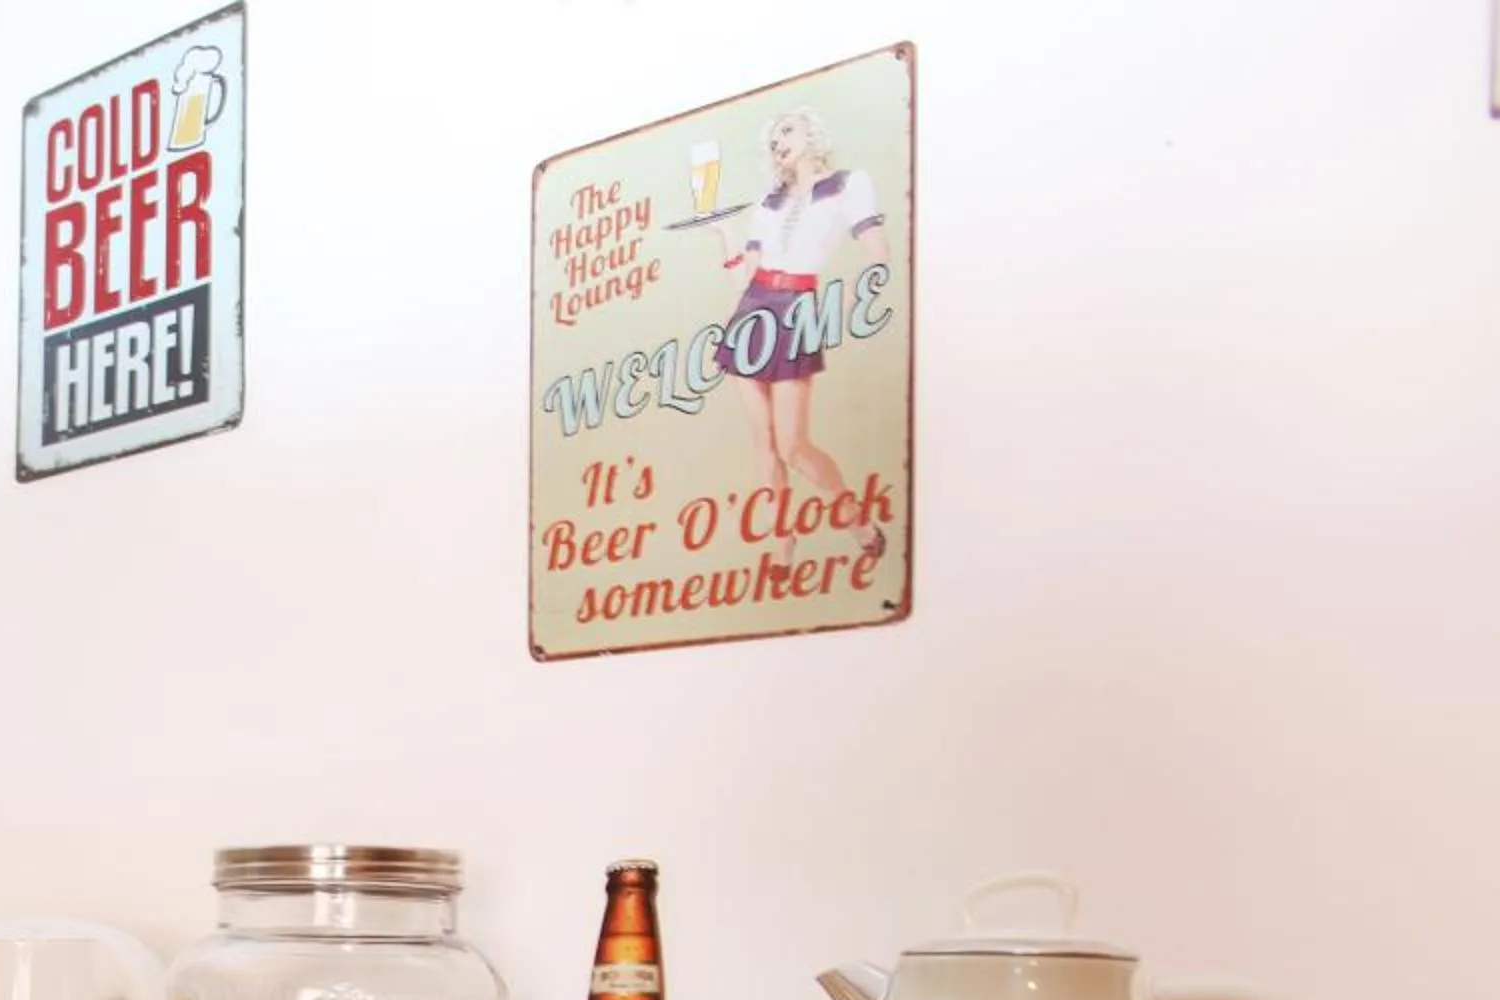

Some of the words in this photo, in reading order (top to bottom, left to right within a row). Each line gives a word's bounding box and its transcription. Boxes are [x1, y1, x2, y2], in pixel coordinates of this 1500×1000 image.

[46, 77, 160, 204] COLD
[550, 196, 651, 259] Happy
[570, 181, 621, 219] The
[44, 151, 212, 331] BEER
[564, 237, 643, 289] Hour
[550, 258, 661, 326] Lounge
[55, 303, 196, 434] HERE!
[543, 262, 894, 438] WELCOME
[582, 455, 653, 508] It's
[542, 519, 657, 571] Beer
[677, 473, 894, 551] O'Clock
[576, 552, 879, 624] somewhere
